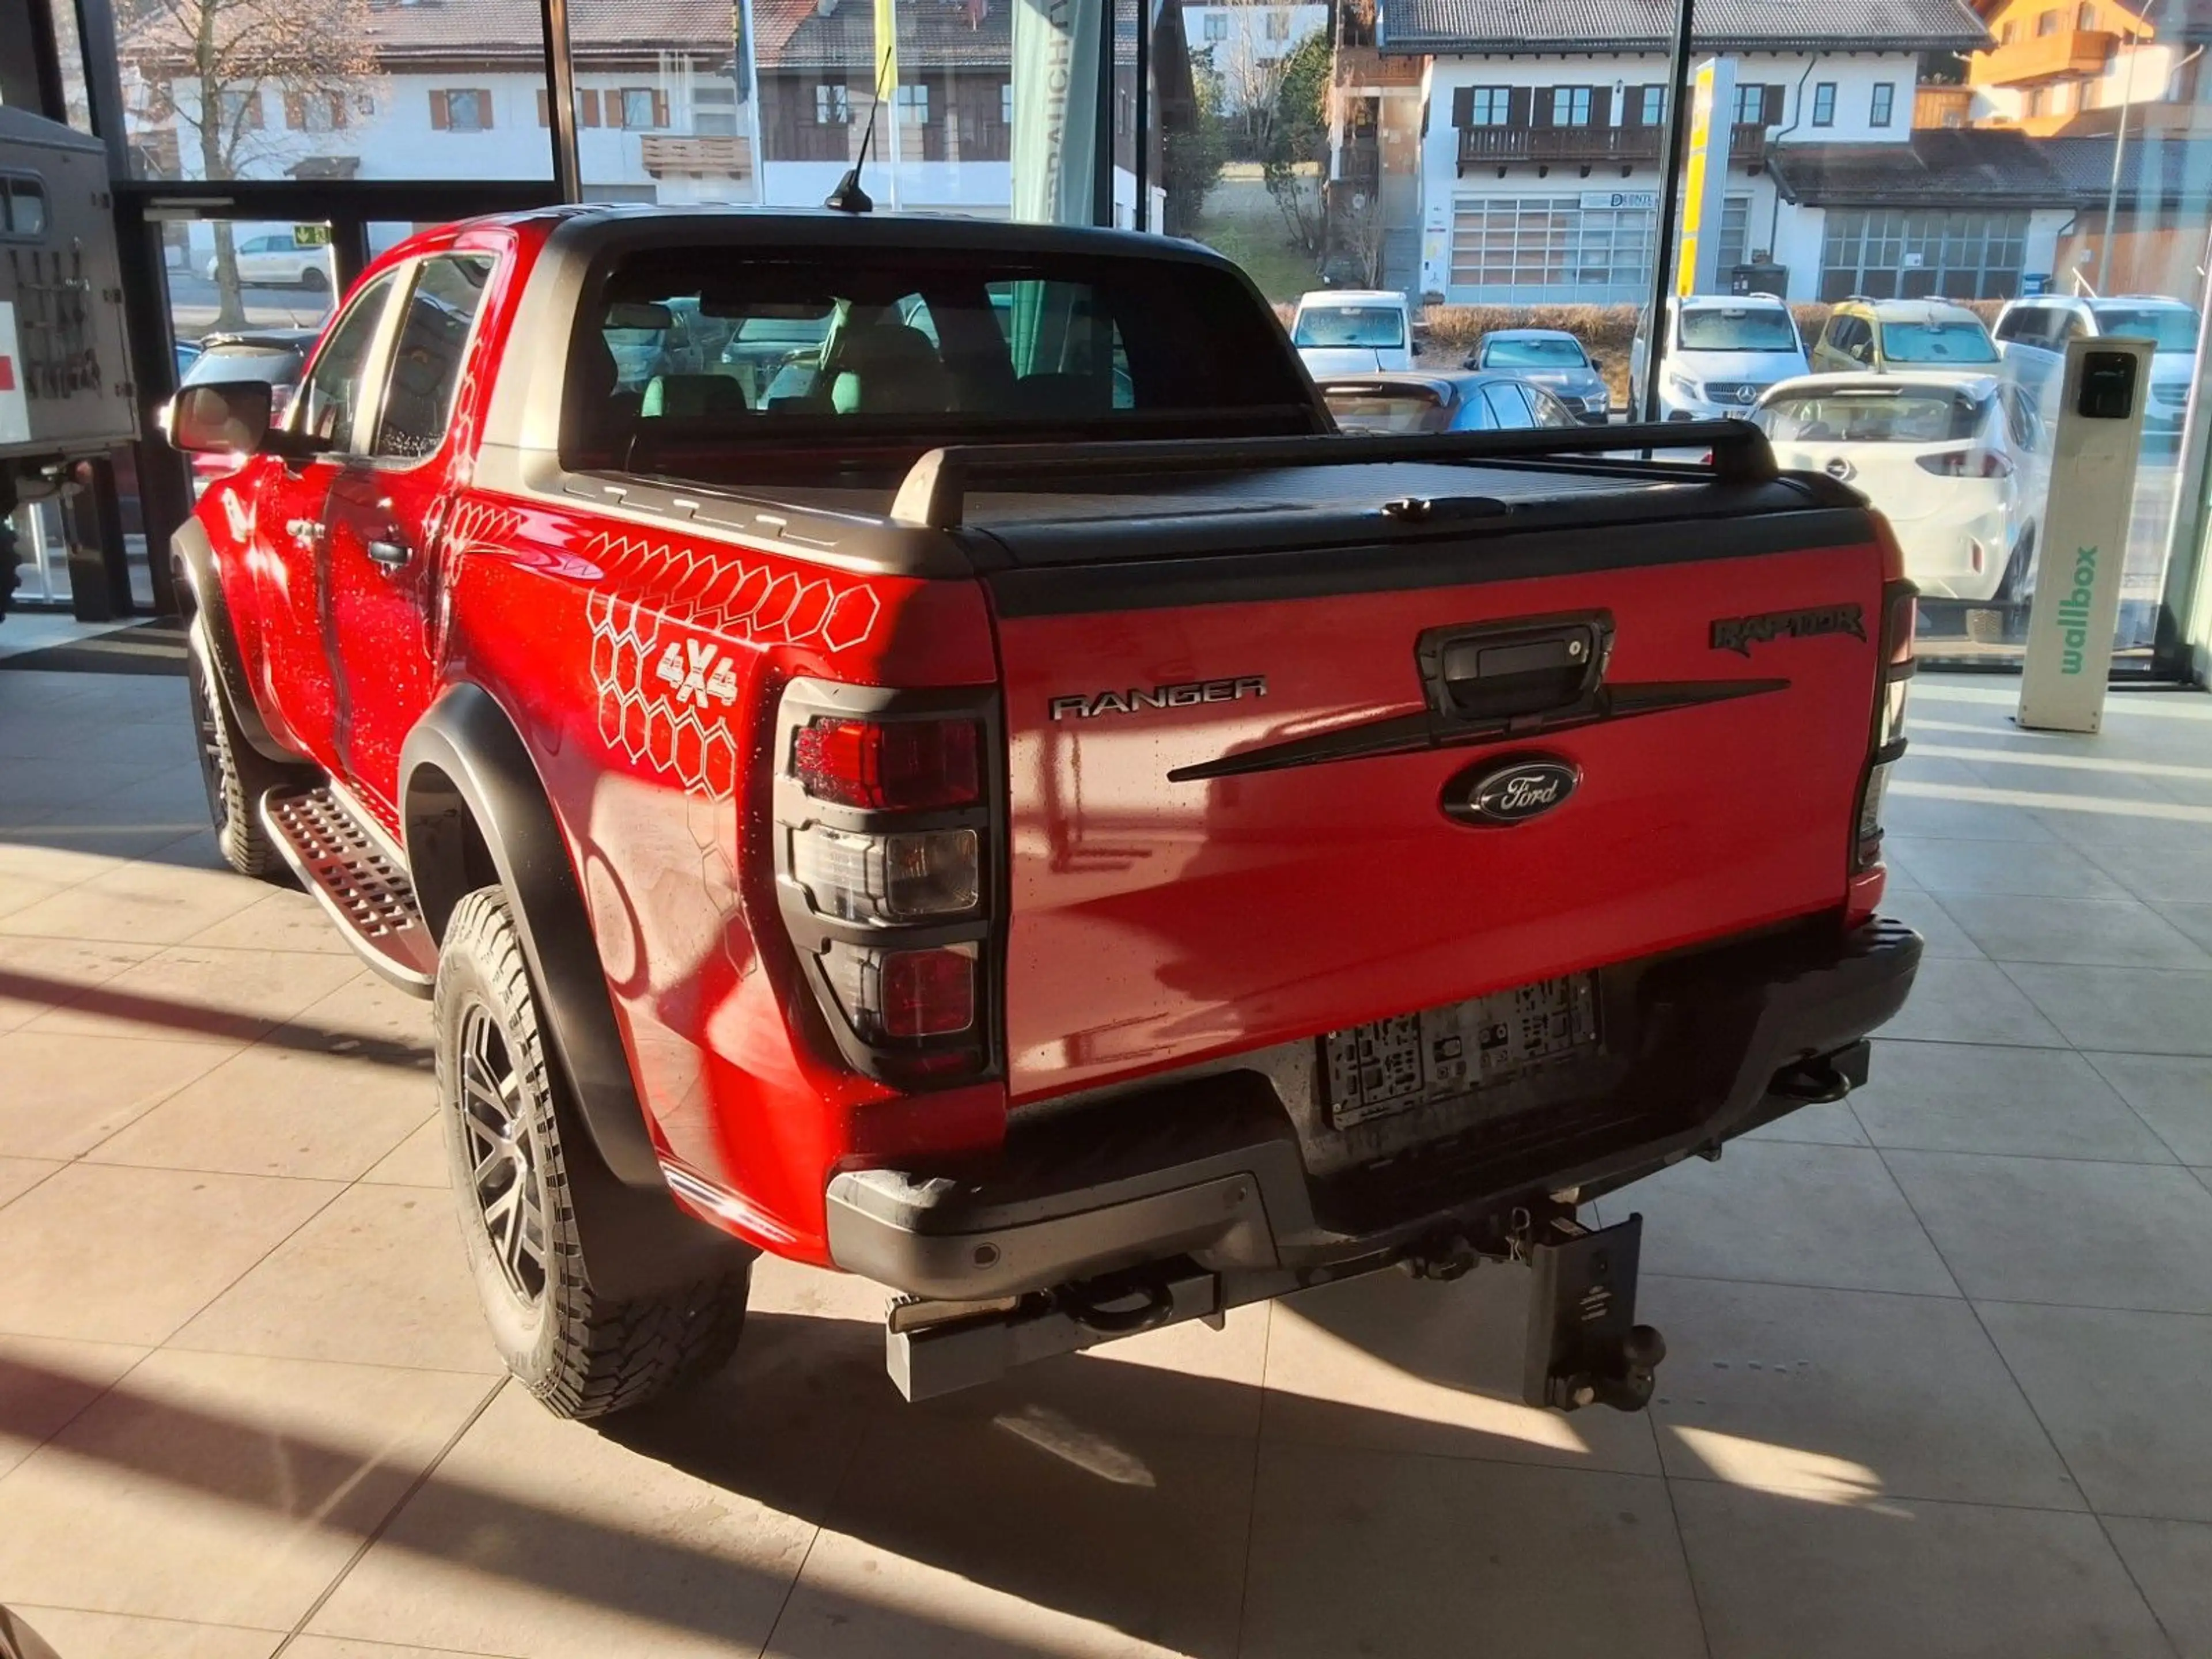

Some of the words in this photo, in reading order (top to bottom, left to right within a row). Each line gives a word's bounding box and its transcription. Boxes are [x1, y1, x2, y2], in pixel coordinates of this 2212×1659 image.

[1709, 603, 1868, 658] RAPTOR
[2057, 546, 2099, 674] wallbox
[1049, 675, 1268, 721] RANGER
[1501, 775, 1558, 809] Ford
